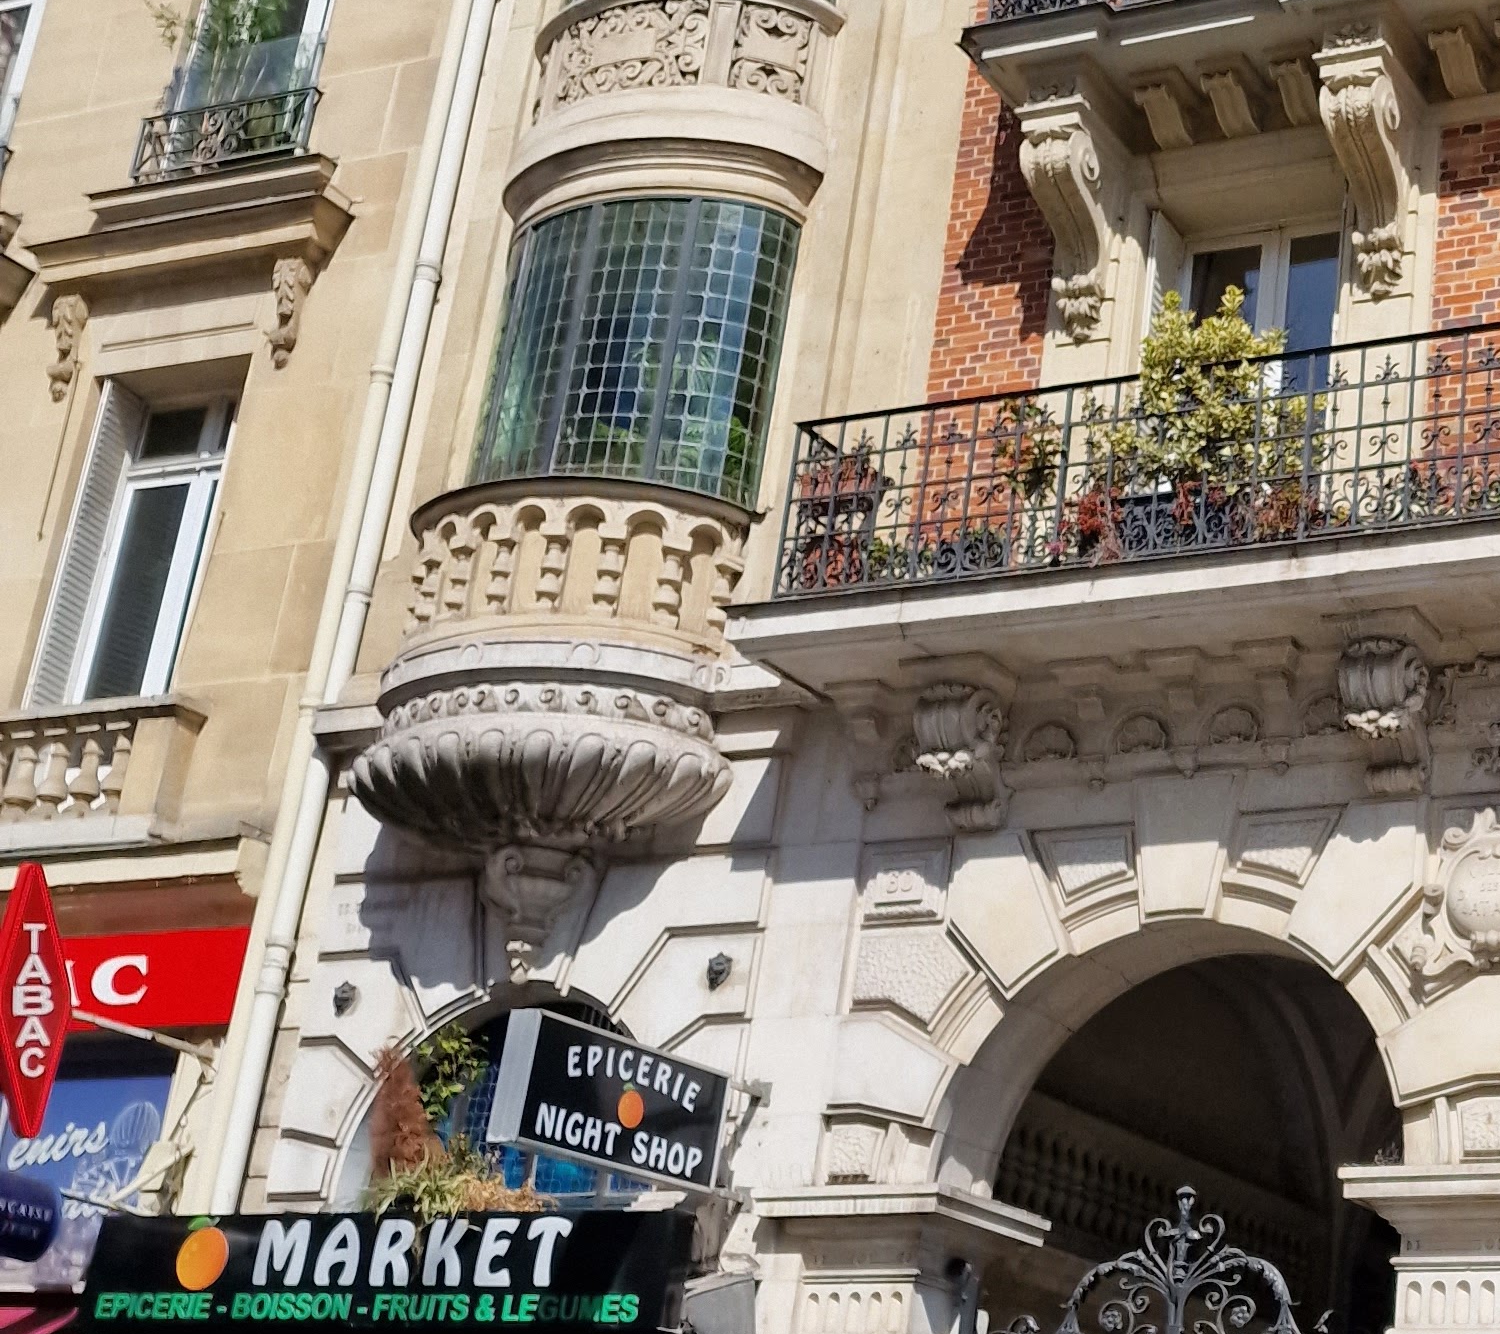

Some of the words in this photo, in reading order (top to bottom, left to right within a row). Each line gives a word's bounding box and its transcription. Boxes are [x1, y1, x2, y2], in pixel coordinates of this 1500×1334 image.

[12, 922, 54, 1078] TABAC
[567, 1045, 701, 1113] EPICERIE
[535, 1102, 622, 1156] NIGHT
[631, 1131, 703, 1179] SHOP
[252, 1216, 573, 1287] MARKET
[95, 1292, 213, 1321] EPICERIE
[231, 1293, 353, 1322] BOISSON
[372, 1293, 469, 1323] FRUITS
[475, 1293, 495, 1323] &
[501, 1293, 639, 1324] LEGUMES
